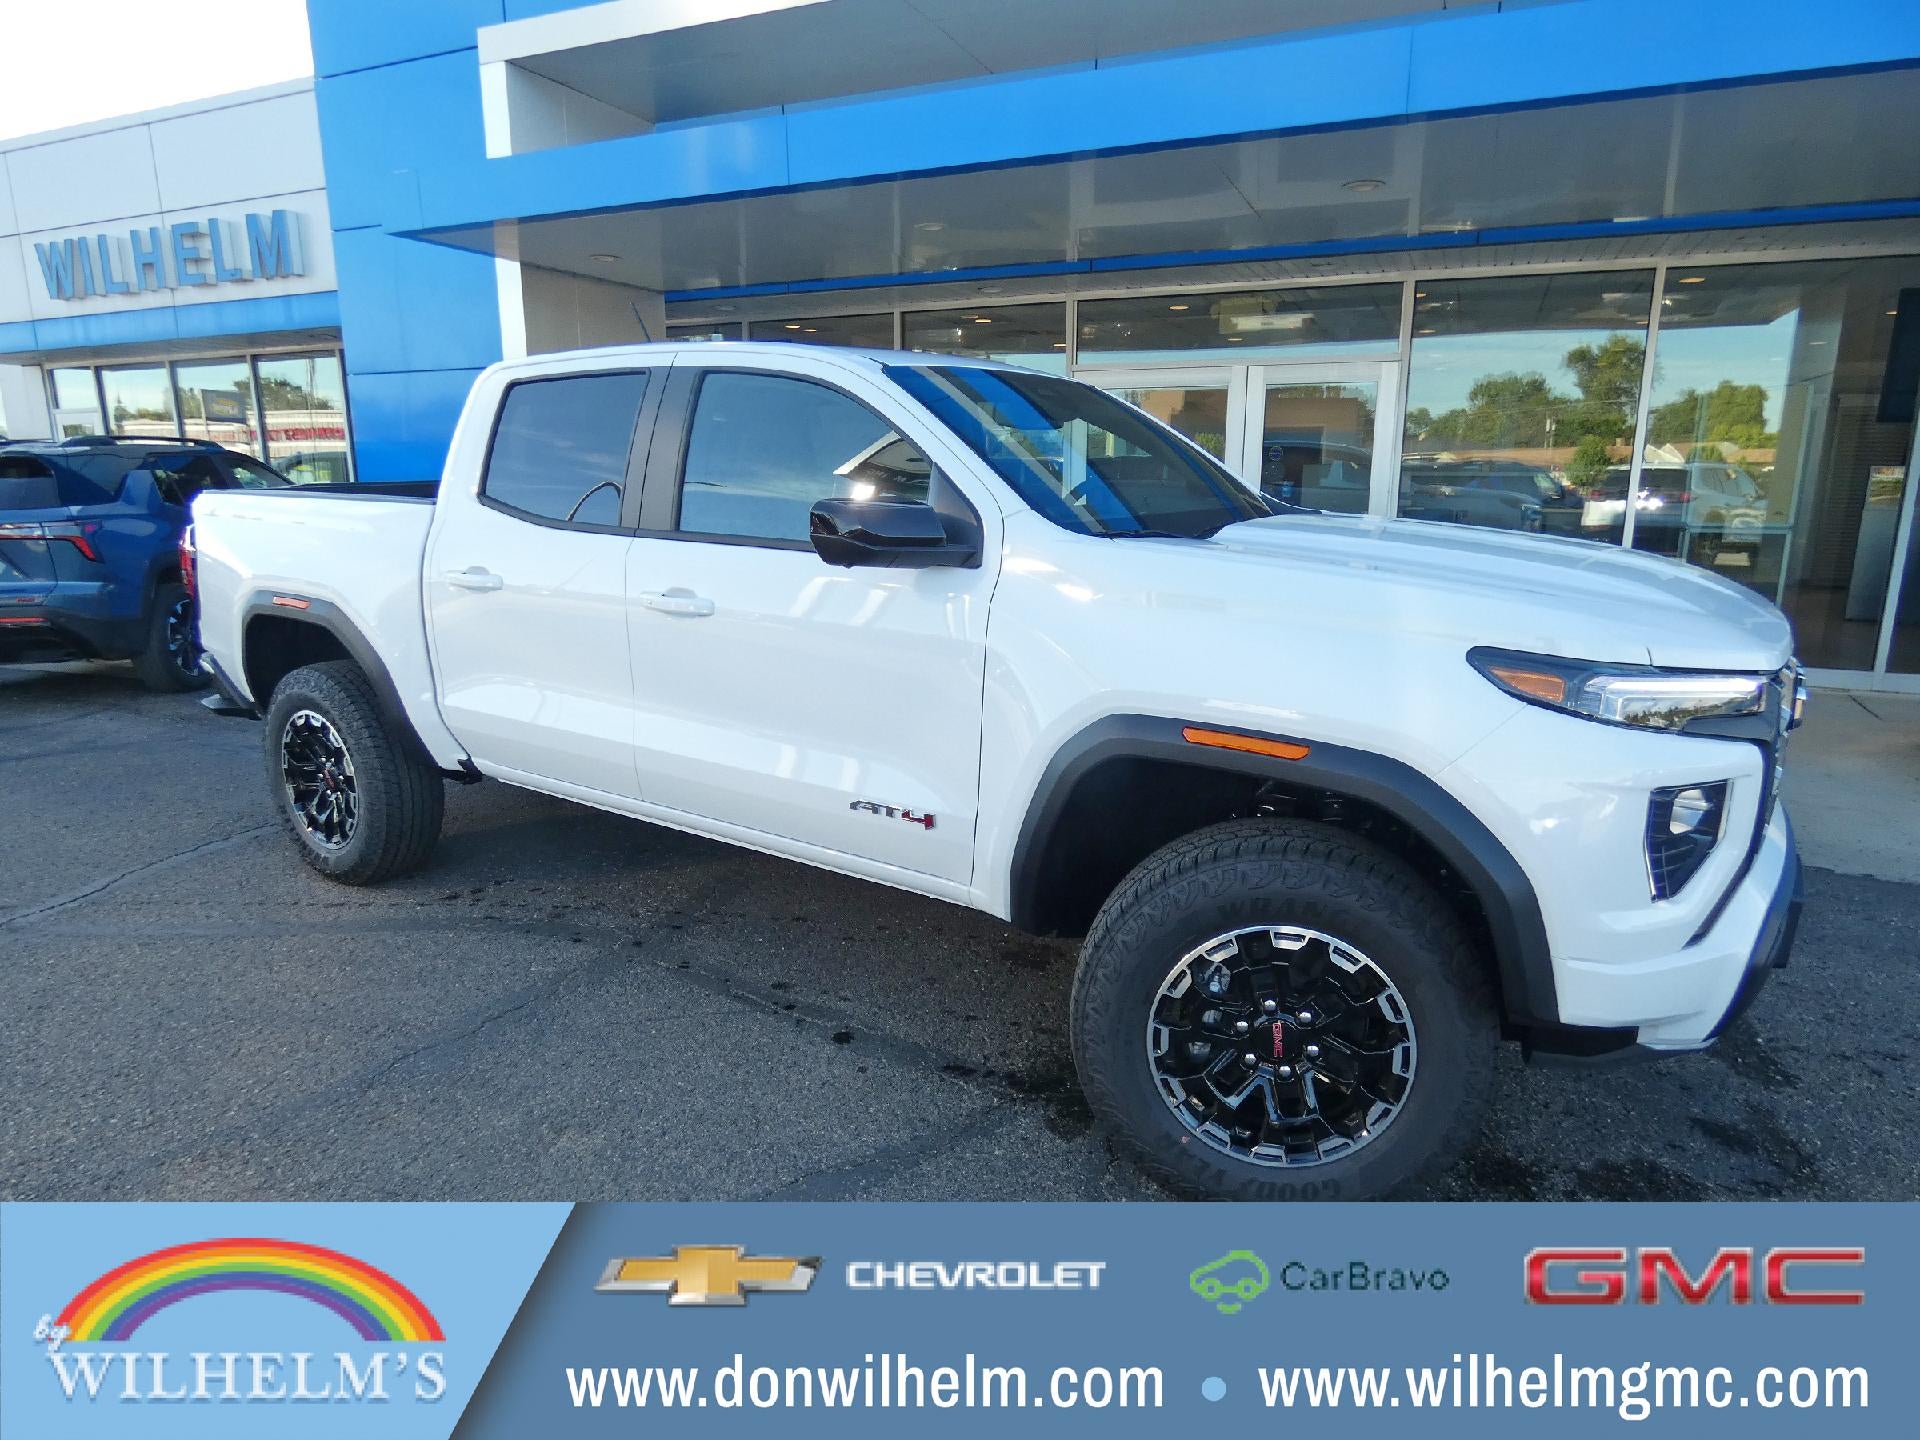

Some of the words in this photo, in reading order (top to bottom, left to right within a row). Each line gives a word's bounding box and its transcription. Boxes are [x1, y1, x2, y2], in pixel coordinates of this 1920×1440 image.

[34, 209, 300, 301] WILHELM
[849, 800, 936, 830] AT4
[1272, 1022, 1283, 1058] GMC
